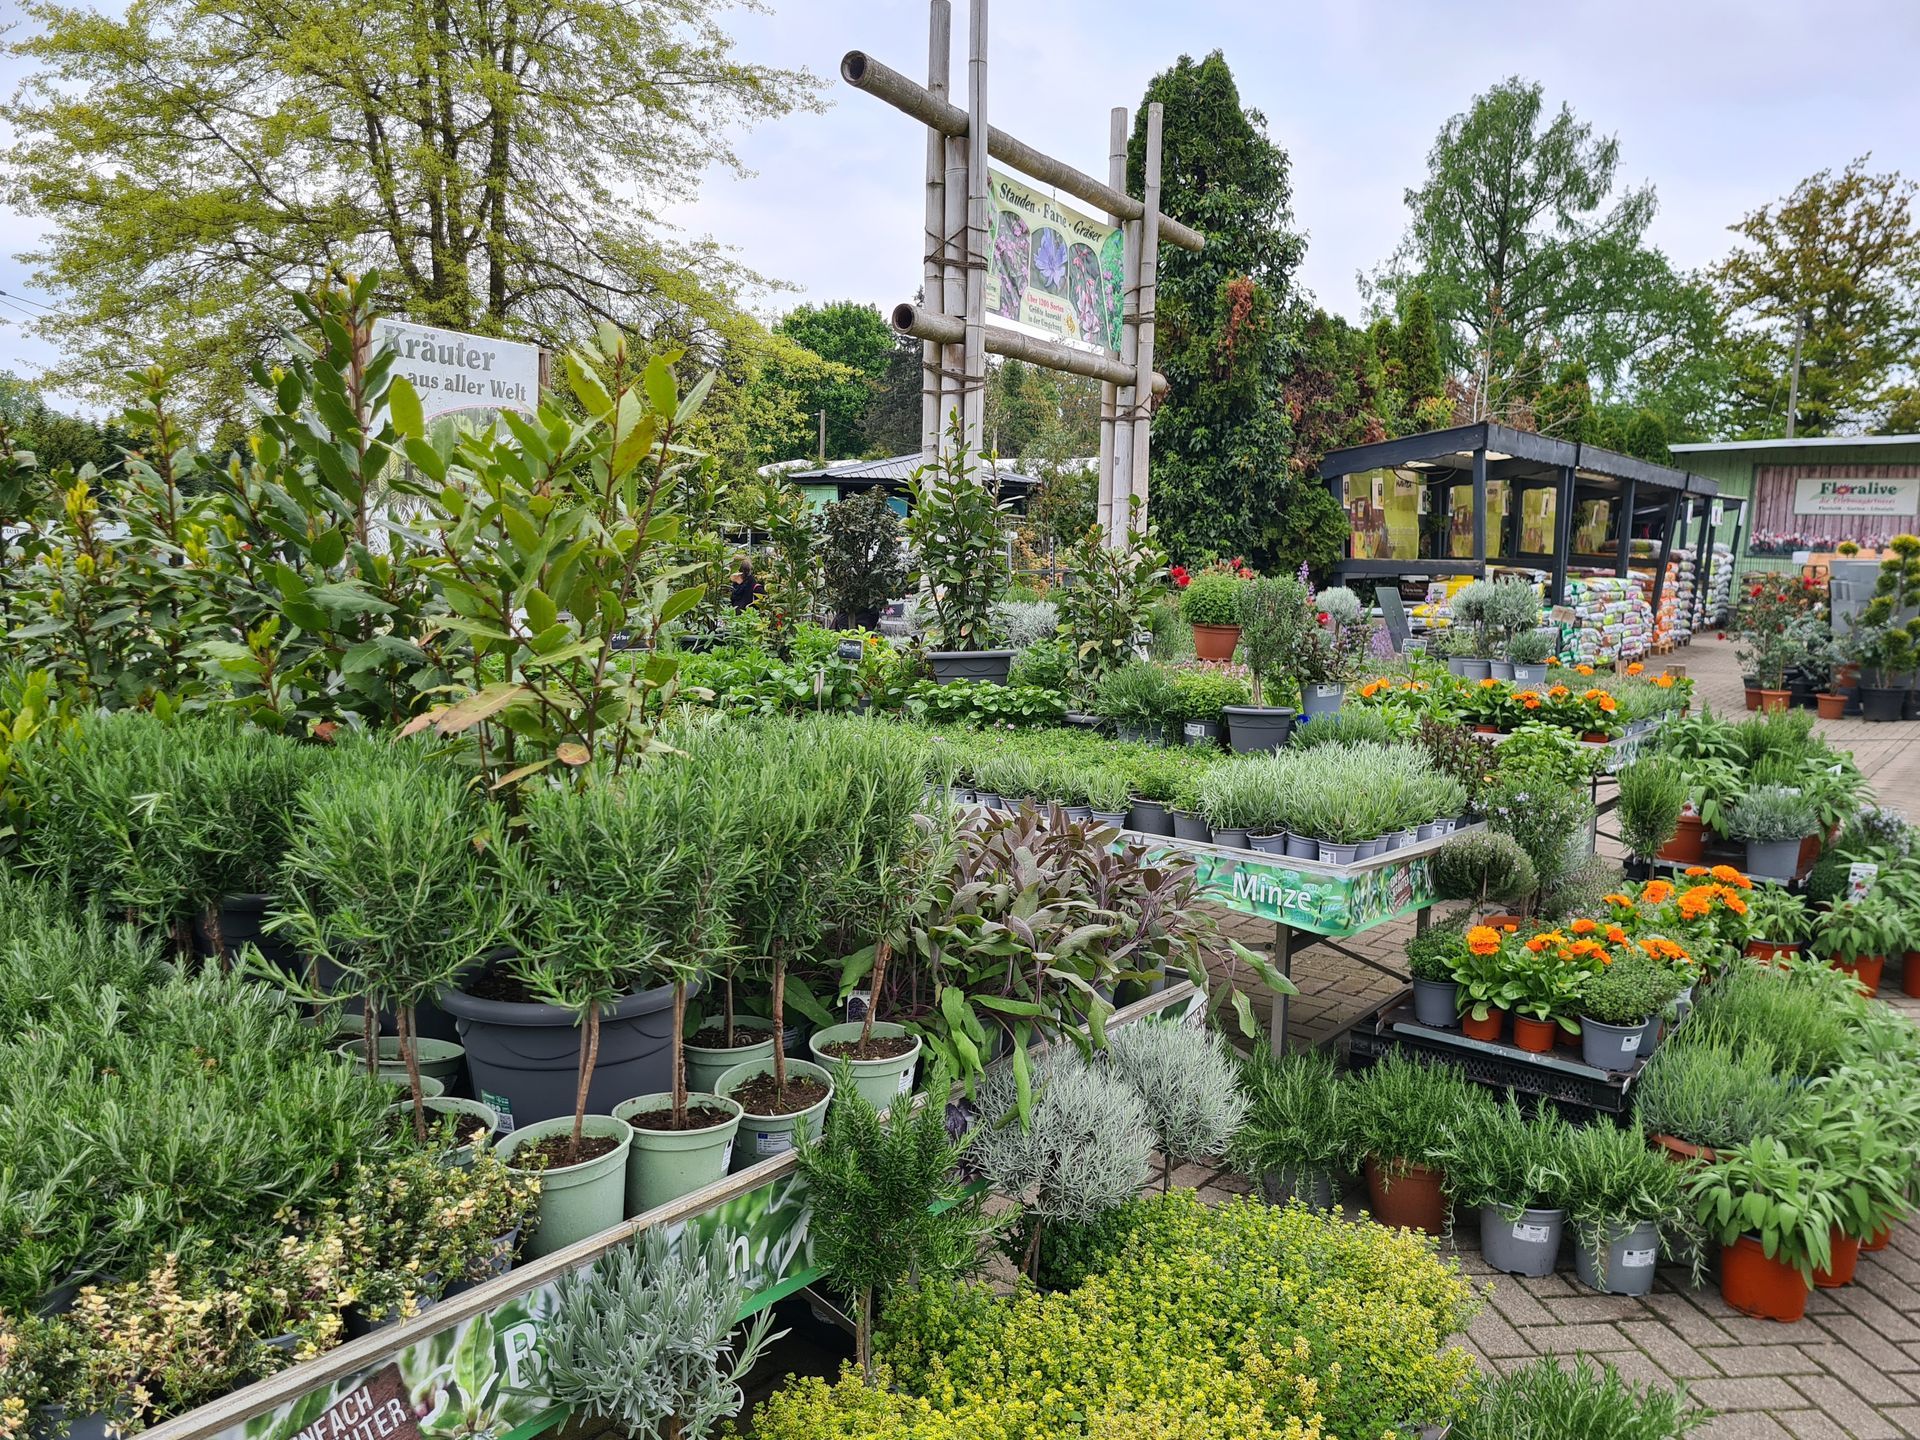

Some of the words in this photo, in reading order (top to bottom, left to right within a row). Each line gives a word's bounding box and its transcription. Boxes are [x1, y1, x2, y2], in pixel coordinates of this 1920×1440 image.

[1000, 182, 1036, 214] Stauden
[1073, 220, 1103, 244] Gräser
[384, 325, 496, 372] Kräuter
[408, 371, 439, 389] aus
[444, 373, 486, 395] aller
[490, 379, 527, 401] Welt
[1820, 482, 1898, 496] Floralive
[1232, 871, 1313, 912] Minze
